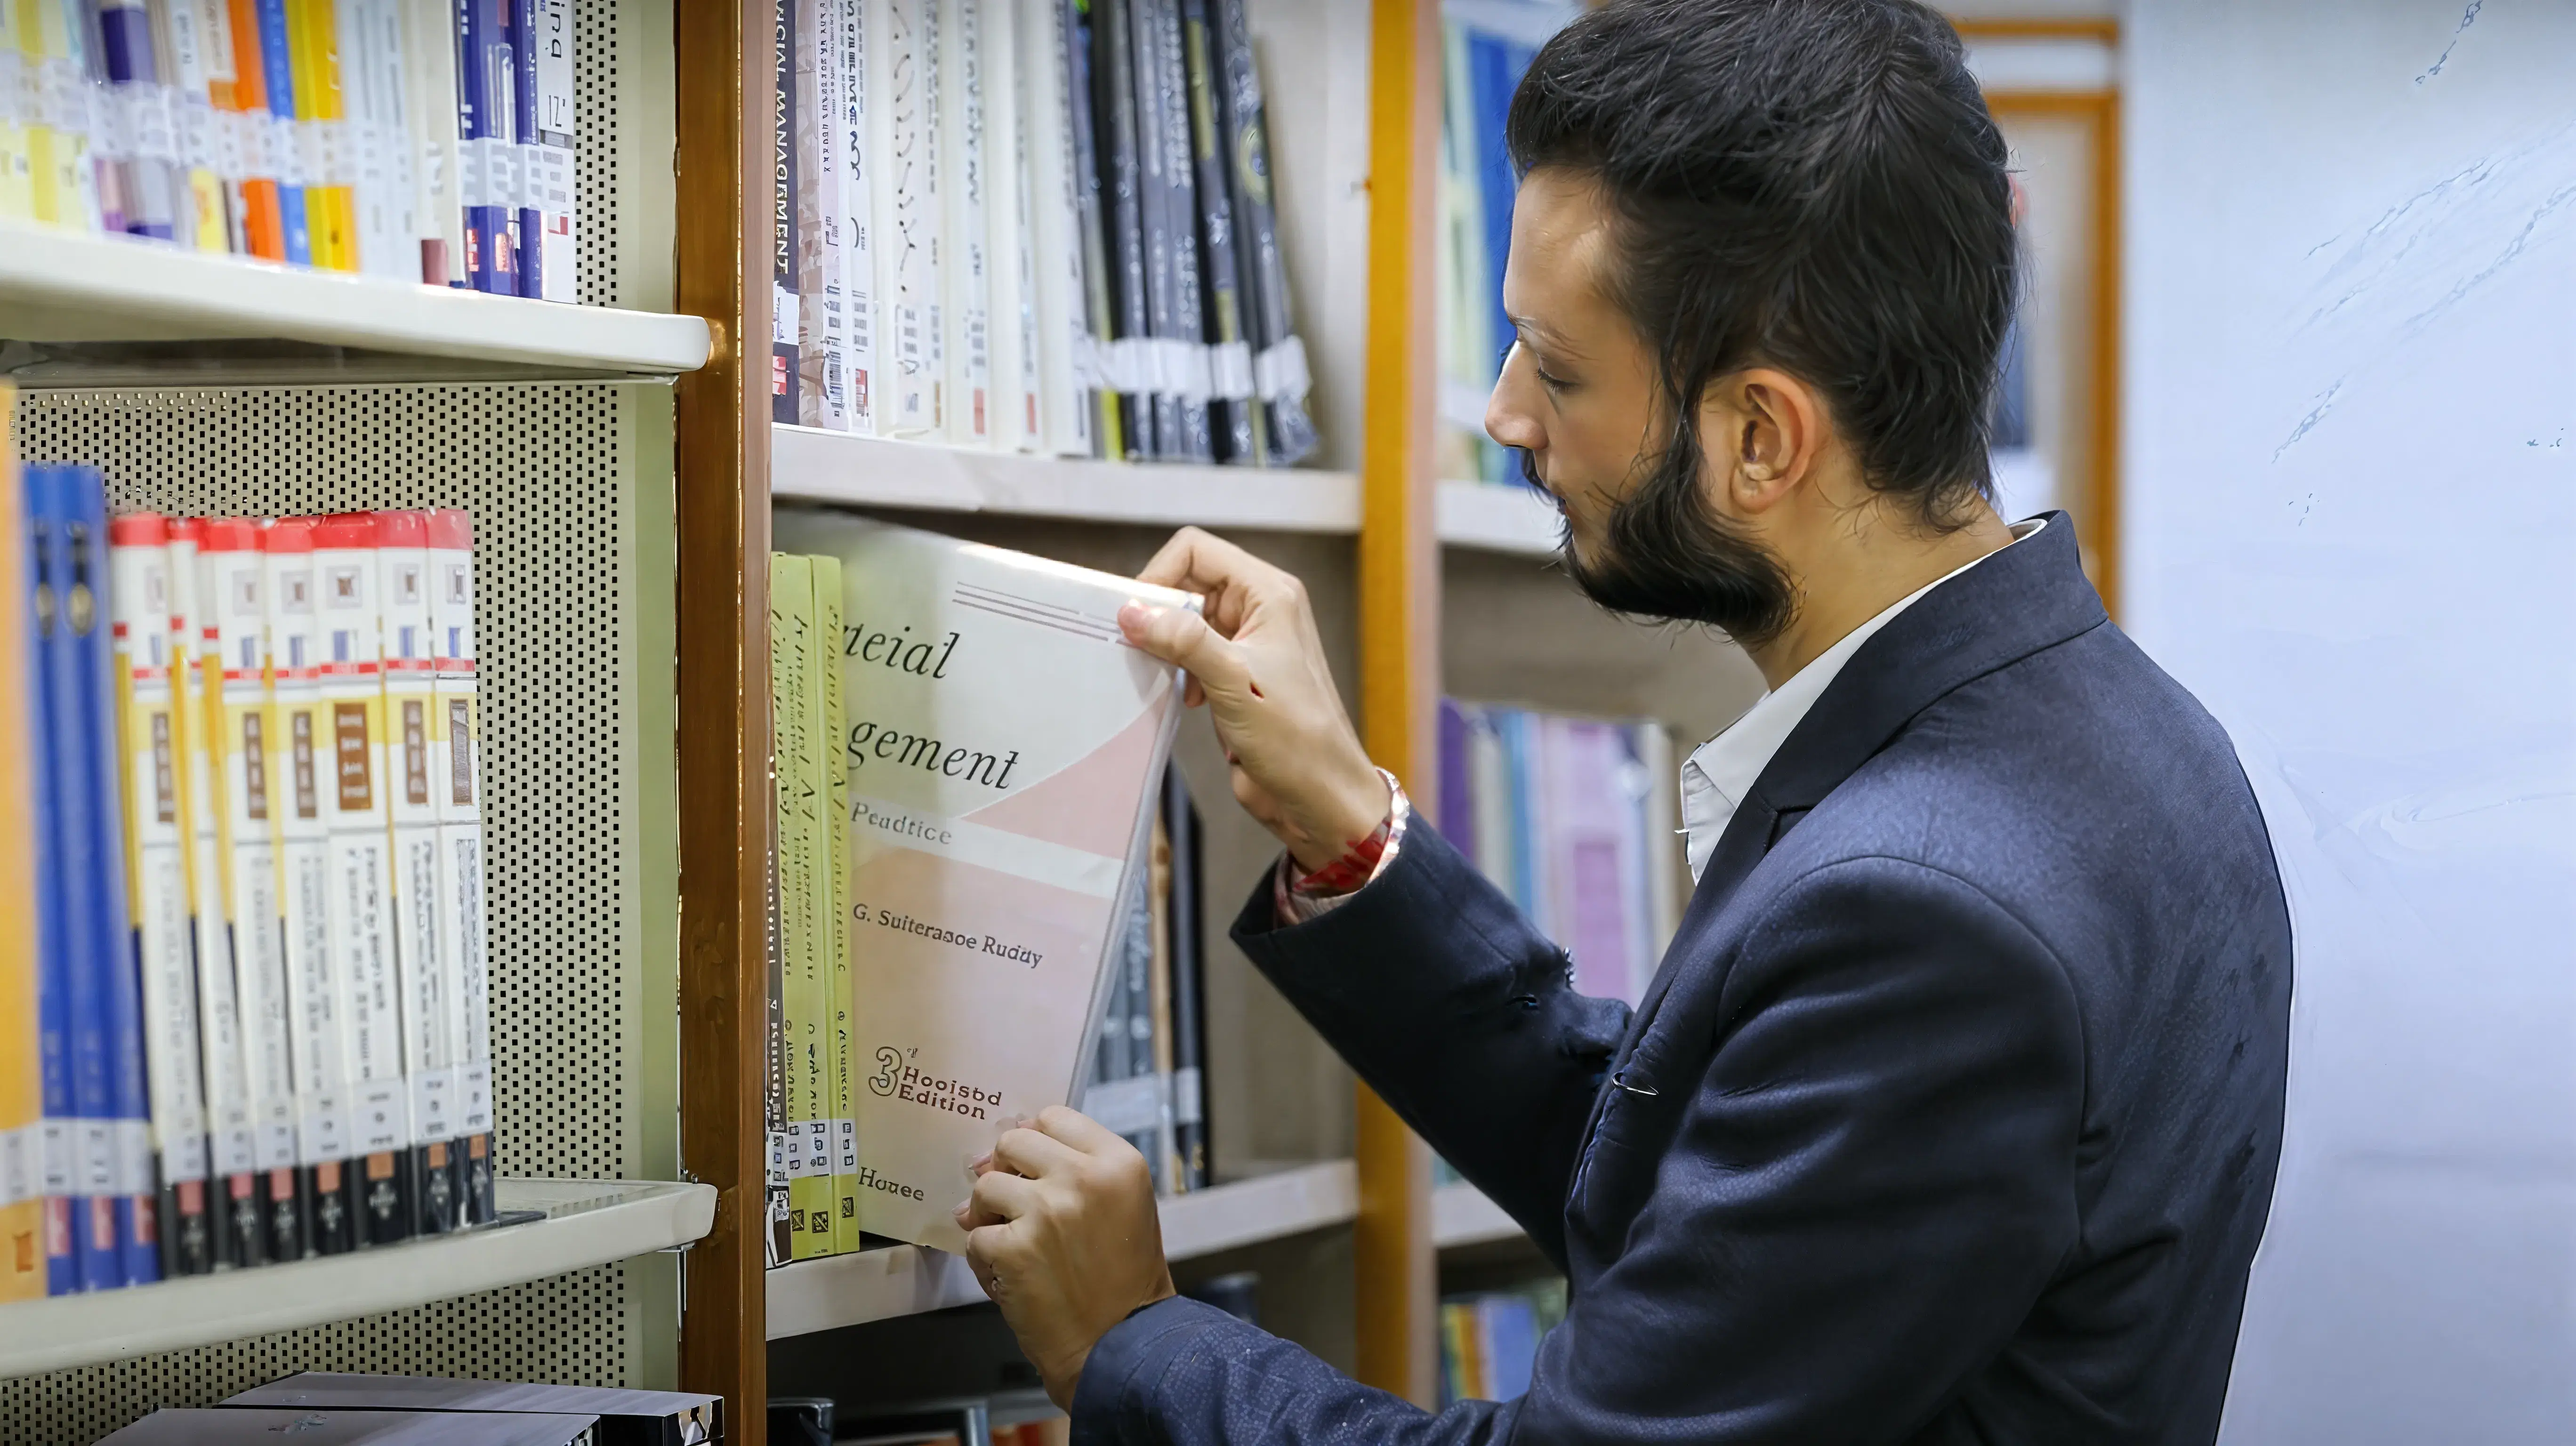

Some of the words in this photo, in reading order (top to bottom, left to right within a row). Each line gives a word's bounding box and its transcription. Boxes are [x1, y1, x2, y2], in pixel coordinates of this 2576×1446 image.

[847, 722, 1019, 789] gement
[868, 1046, 902, 1097] 3
[898, 1083, 985, 1120] Edition
